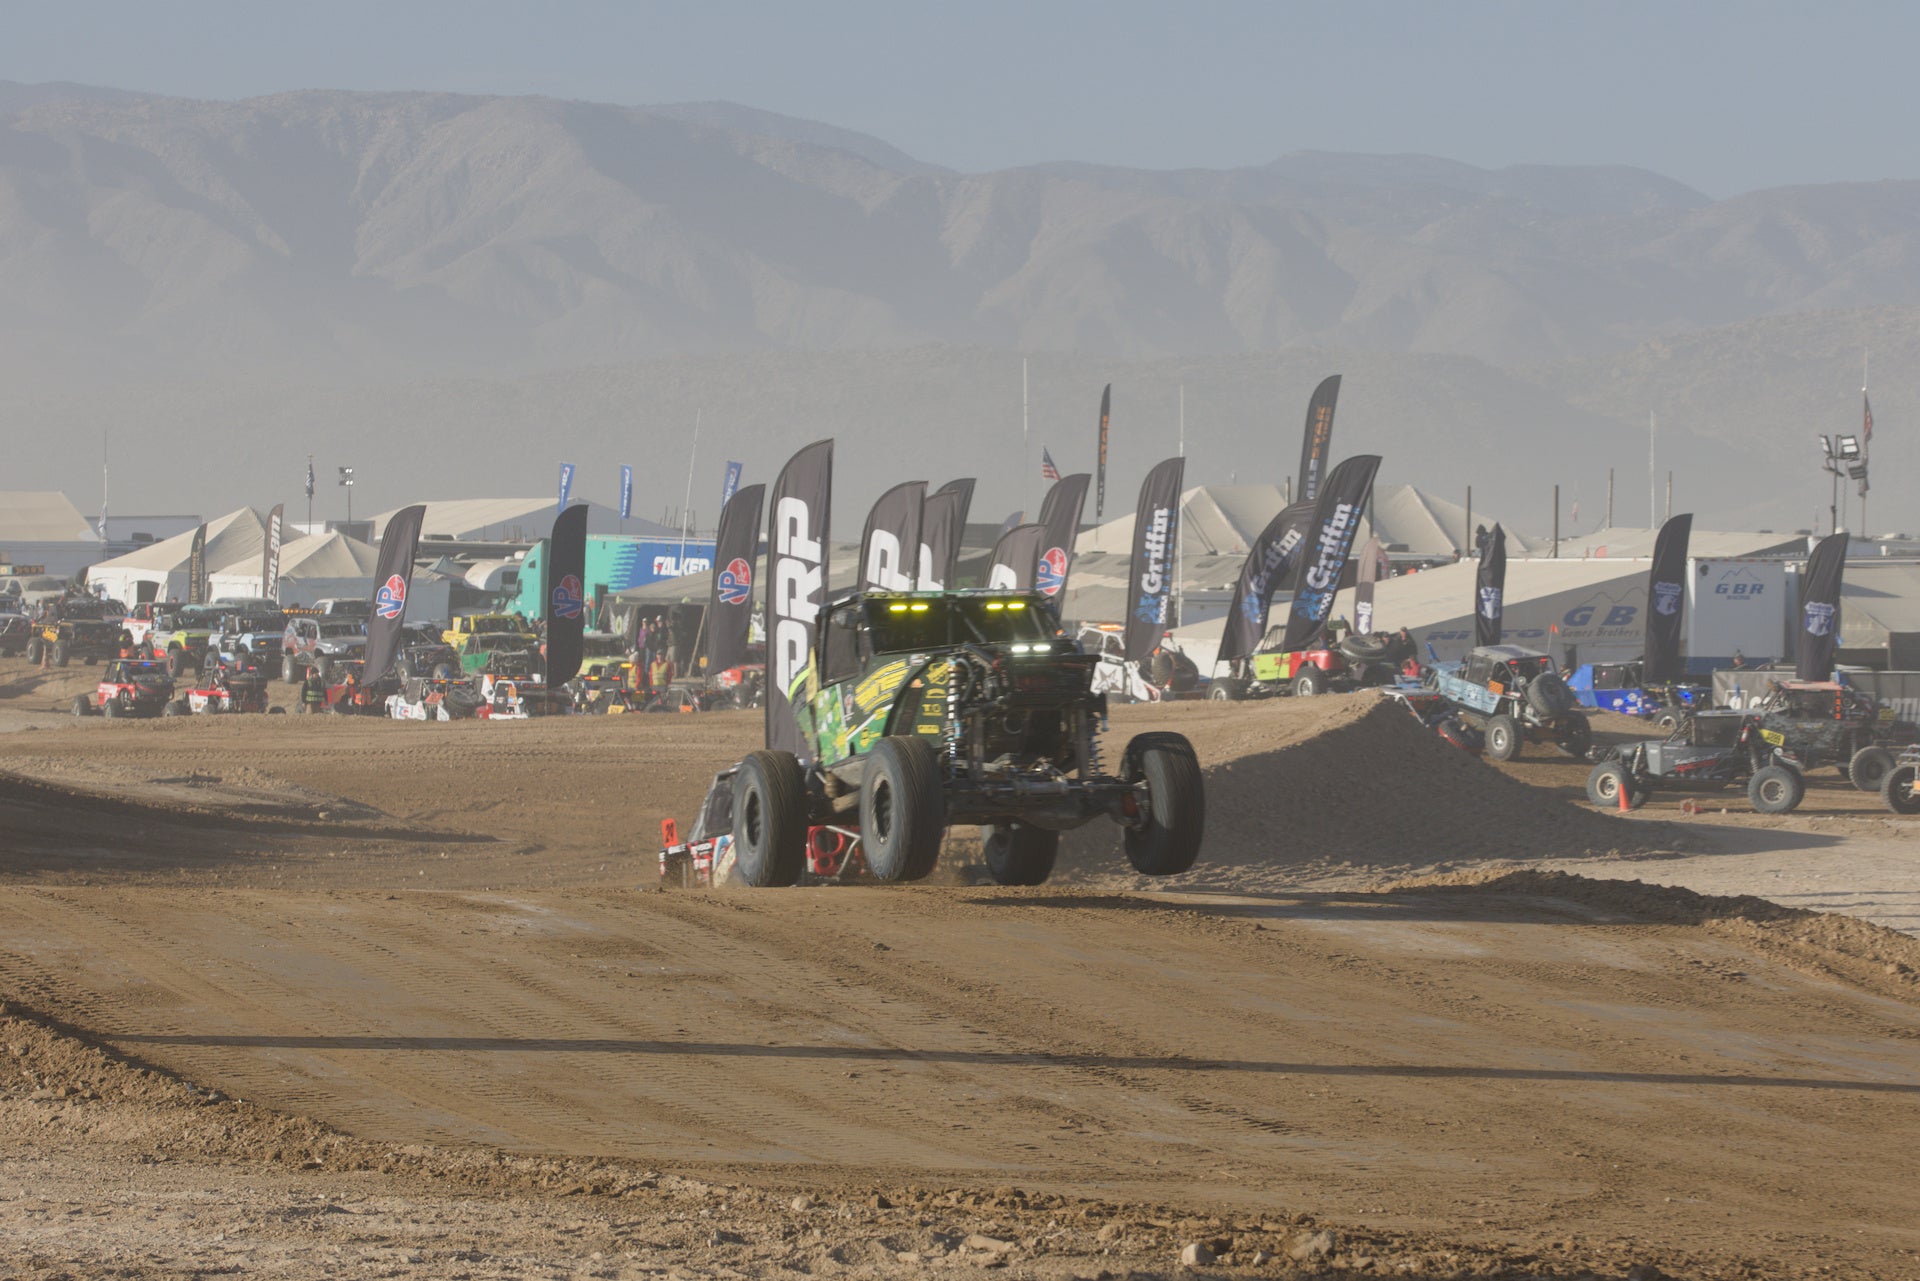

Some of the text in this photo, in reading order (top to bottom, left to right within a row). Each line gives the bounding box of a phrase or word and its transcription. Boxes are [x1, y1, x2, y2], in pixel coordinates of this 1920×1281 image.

[1142, 507, 1169, 594] Griffin
[1250, 528, 1302, 594] Griffin
[1307, 502, 1353, 590] Griffin
[652, 555, 710, 577] FALKEN
[1036, 559, 1064, 590] VP
[376, 586, 403, 617] VP
[553, 587, 581, 617] VP
[718, 570, 749, 603] VP
